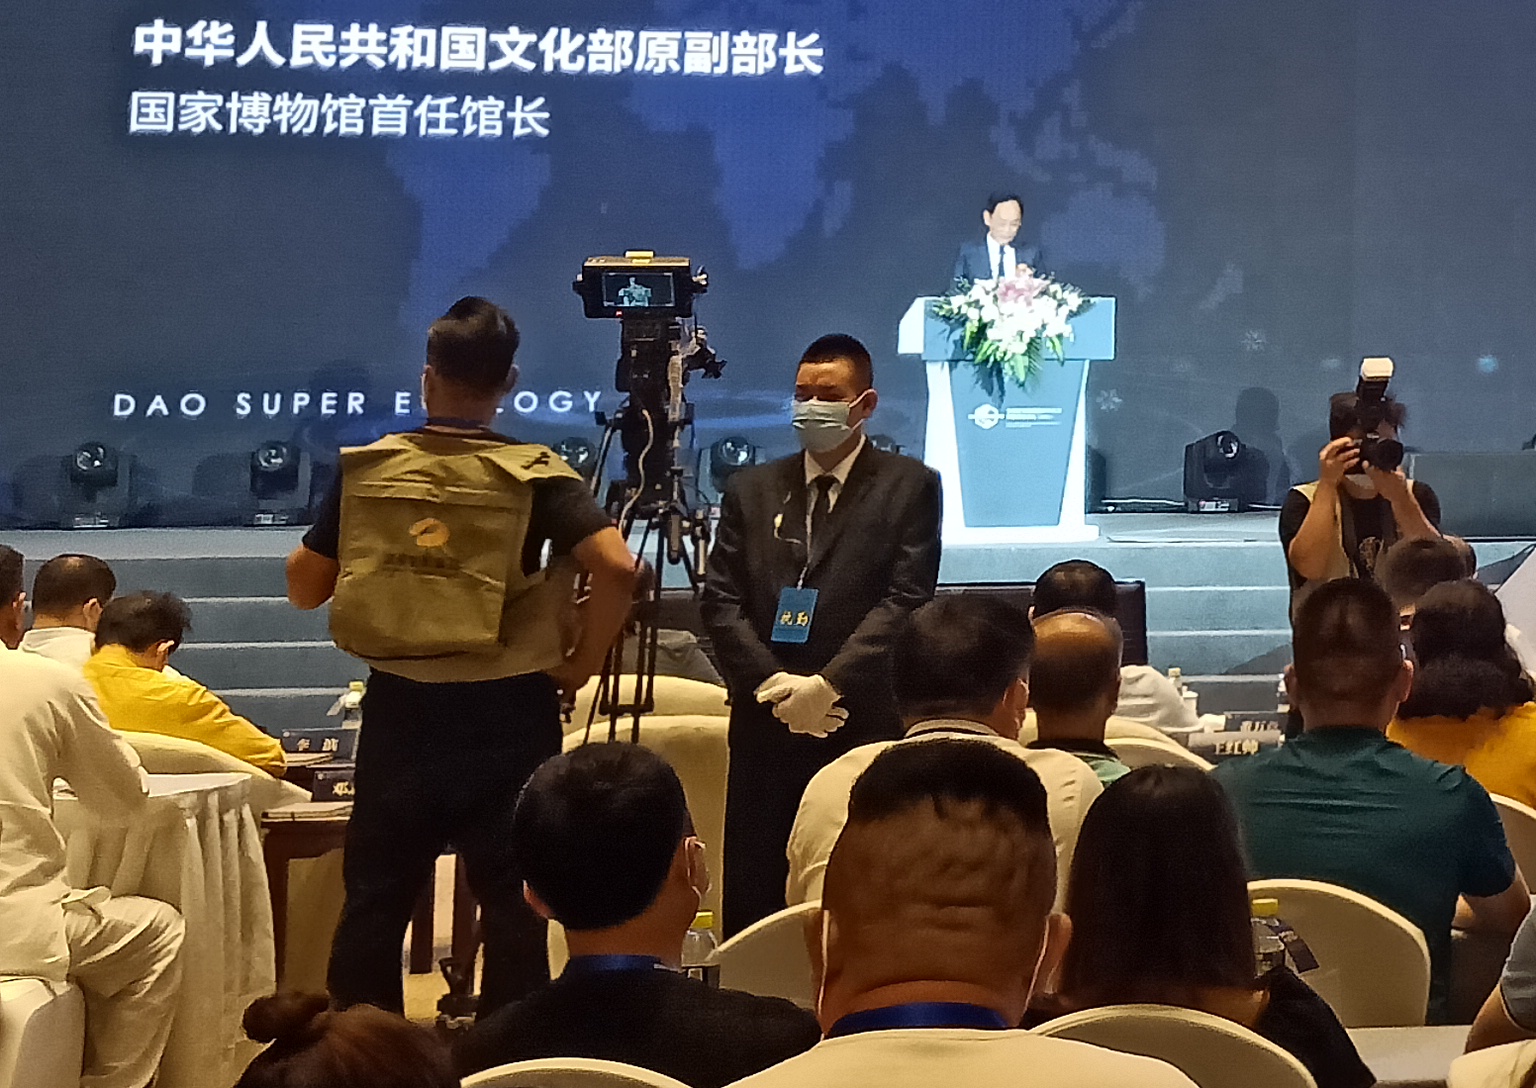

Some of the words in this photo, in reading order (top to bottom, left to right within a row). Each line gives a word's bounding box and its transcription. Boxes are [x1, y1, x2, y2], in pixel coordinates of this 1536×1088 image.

[133, 18, 825, 77] 中华人民共和国文化部原副部长
[129, 90, 552, 139] 国家博物馆首任馆长
[114, 393, 206, 416] DAO
[236, 392, 365, 415] SUPER
[395, 390, 602, 414] EOGY
